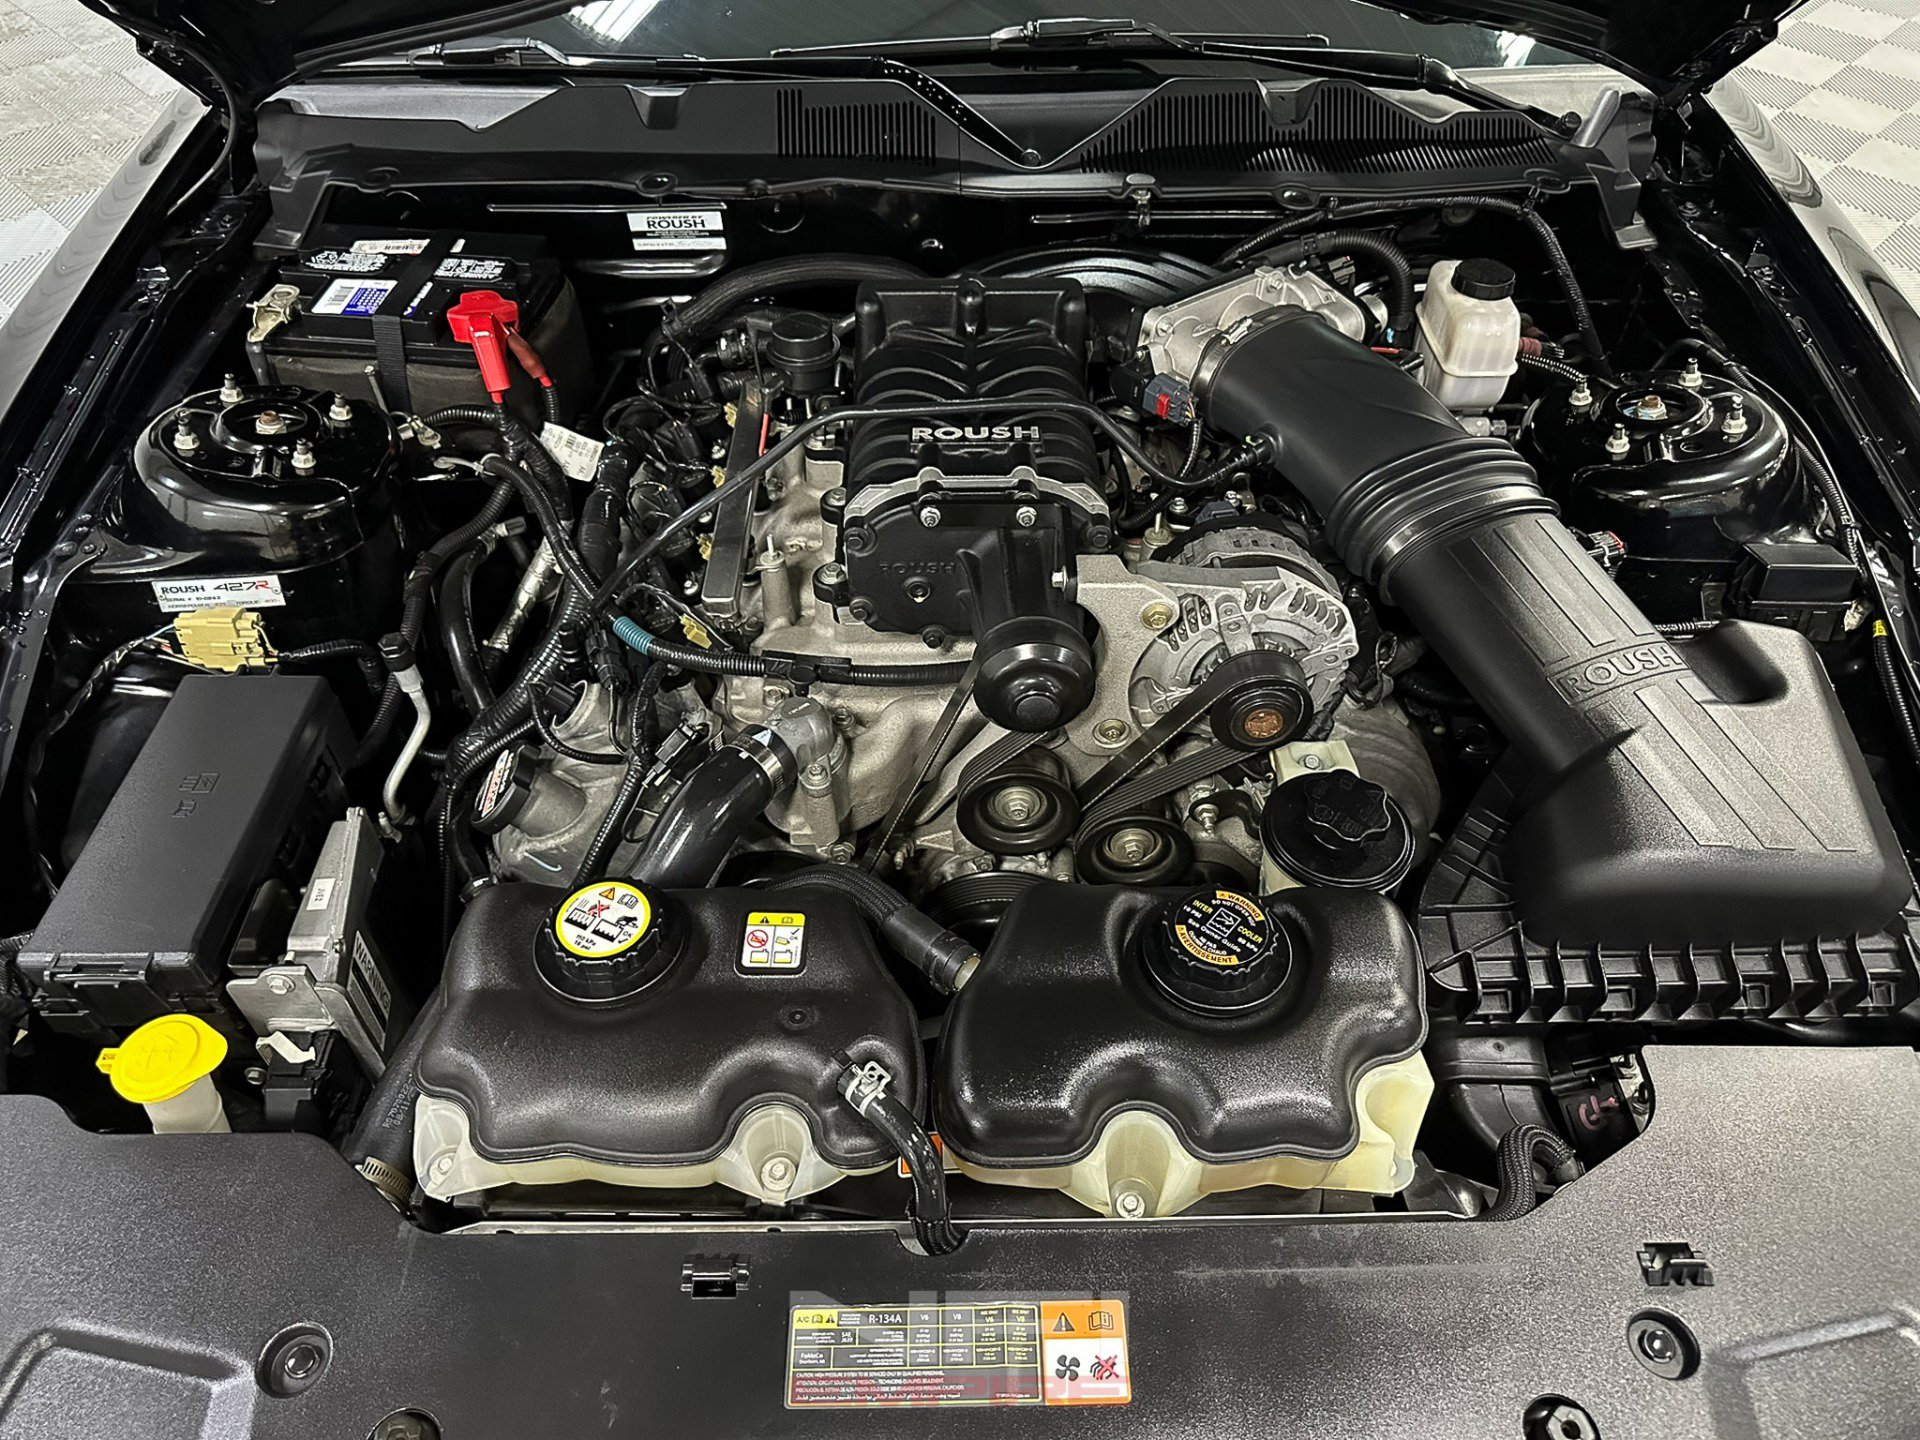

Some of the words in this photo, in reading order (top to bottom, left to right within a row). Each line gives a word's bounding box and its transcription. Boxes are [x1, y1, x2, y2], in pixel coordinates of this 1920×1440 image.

[646, 219, 706, 229] ROUSH
[911, 426, 1040, 441] ROUSH
[878, 561, 956, 575] ROUSH
[161, 584, 205, 595] ROUSH
[214, 580, 271, 592] 427R
[1557, 644, 1683, 699] ROUSH
[1192, 900, 1214, 914] INTER
[1228, 893, 1261, 918] WARNING
[1234, 904, 1250, 918] OPEN
[1188, 918, 1200, 928] See
[1200, 926, 1222, 941] Owner
[1221, 939, 1242, 953] Guide
[1237, 925, 1264, 944] COOLER
[1179, 932, 1233, 964] AVERTISSEMENT
[355, 936, 391, 1011] WARNING
[868, 1313, 903, 1324] R-134A
